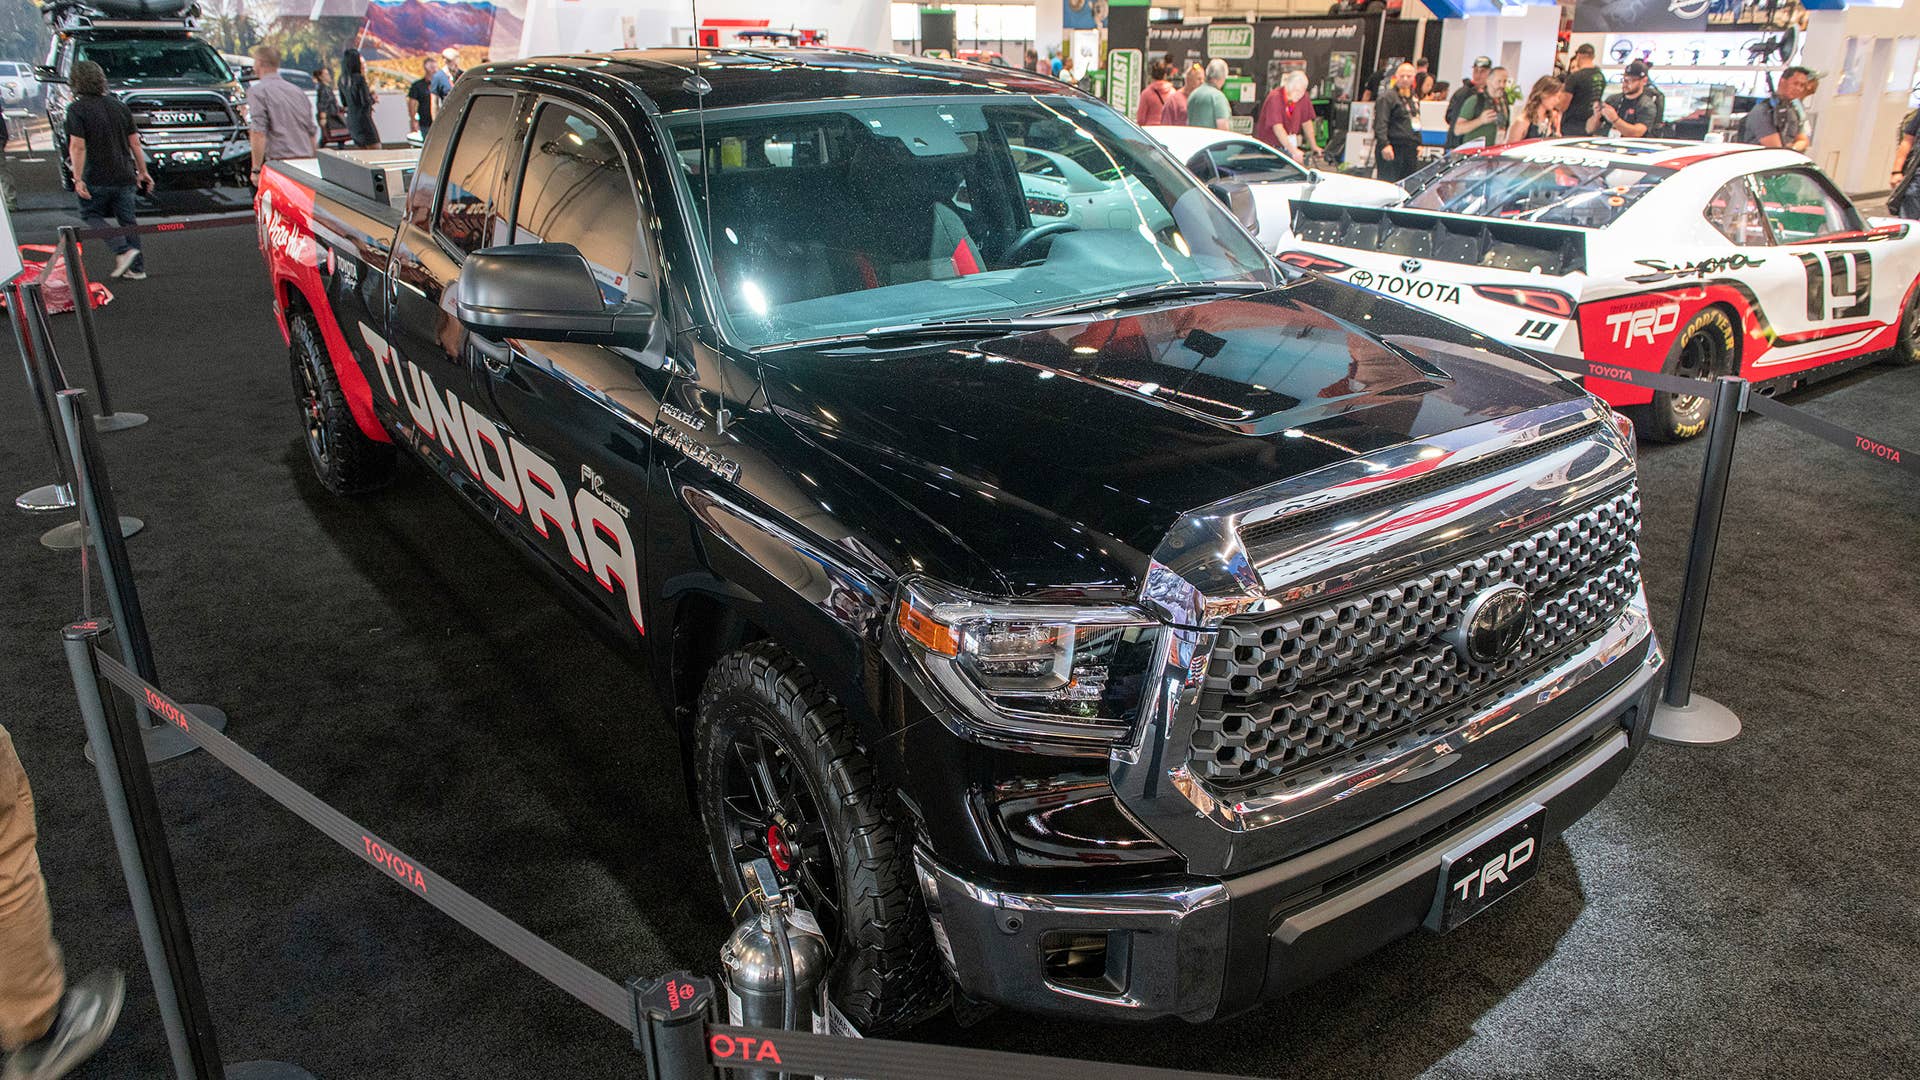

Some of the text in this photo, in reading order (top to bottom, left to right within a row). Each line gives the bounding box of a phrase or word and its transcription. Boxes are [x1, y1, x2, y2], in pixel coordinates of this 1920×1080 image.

[1271, 25, 1289, 38] Are
[1291, 28, 1306, 38] we
[1306, 25, 1317, 38] in
[1317, 27, 1337, 40] your
[155, 112, 203, 122] TOYOTA
[1523, 153, 1610, 168] TOYOTA
[157, 223, 184, 232] TOYOTA
[337, 255, 358, 279] TOYOTA
[1624, 253, 1766, 284] Supra
[1376, 274, 1460, 304] TOYOTA
[1791, 249, 1872, 321] 19
[1515, 319, 1558, 341] 19
[1605, 303, 1681, 349] TRD
[1588, 363, 1633, 382] TOYOTA
[1674, 419, 1706, 438] EAGLE
[653, 422, 742, 485] TUNDRA
[1855, 435, 1901, 463] TOYOTA
[358, 320, 645, 637] TUNDRA
[143, 687, 189, 732] TOYOTA
[362, 835, 427, 892] TOYOTA
[1453, 836, 1535, 902] TRD
[666, 979, 681, 1012] TOYOTA
[709, 1033, 782, 1065] OTA
